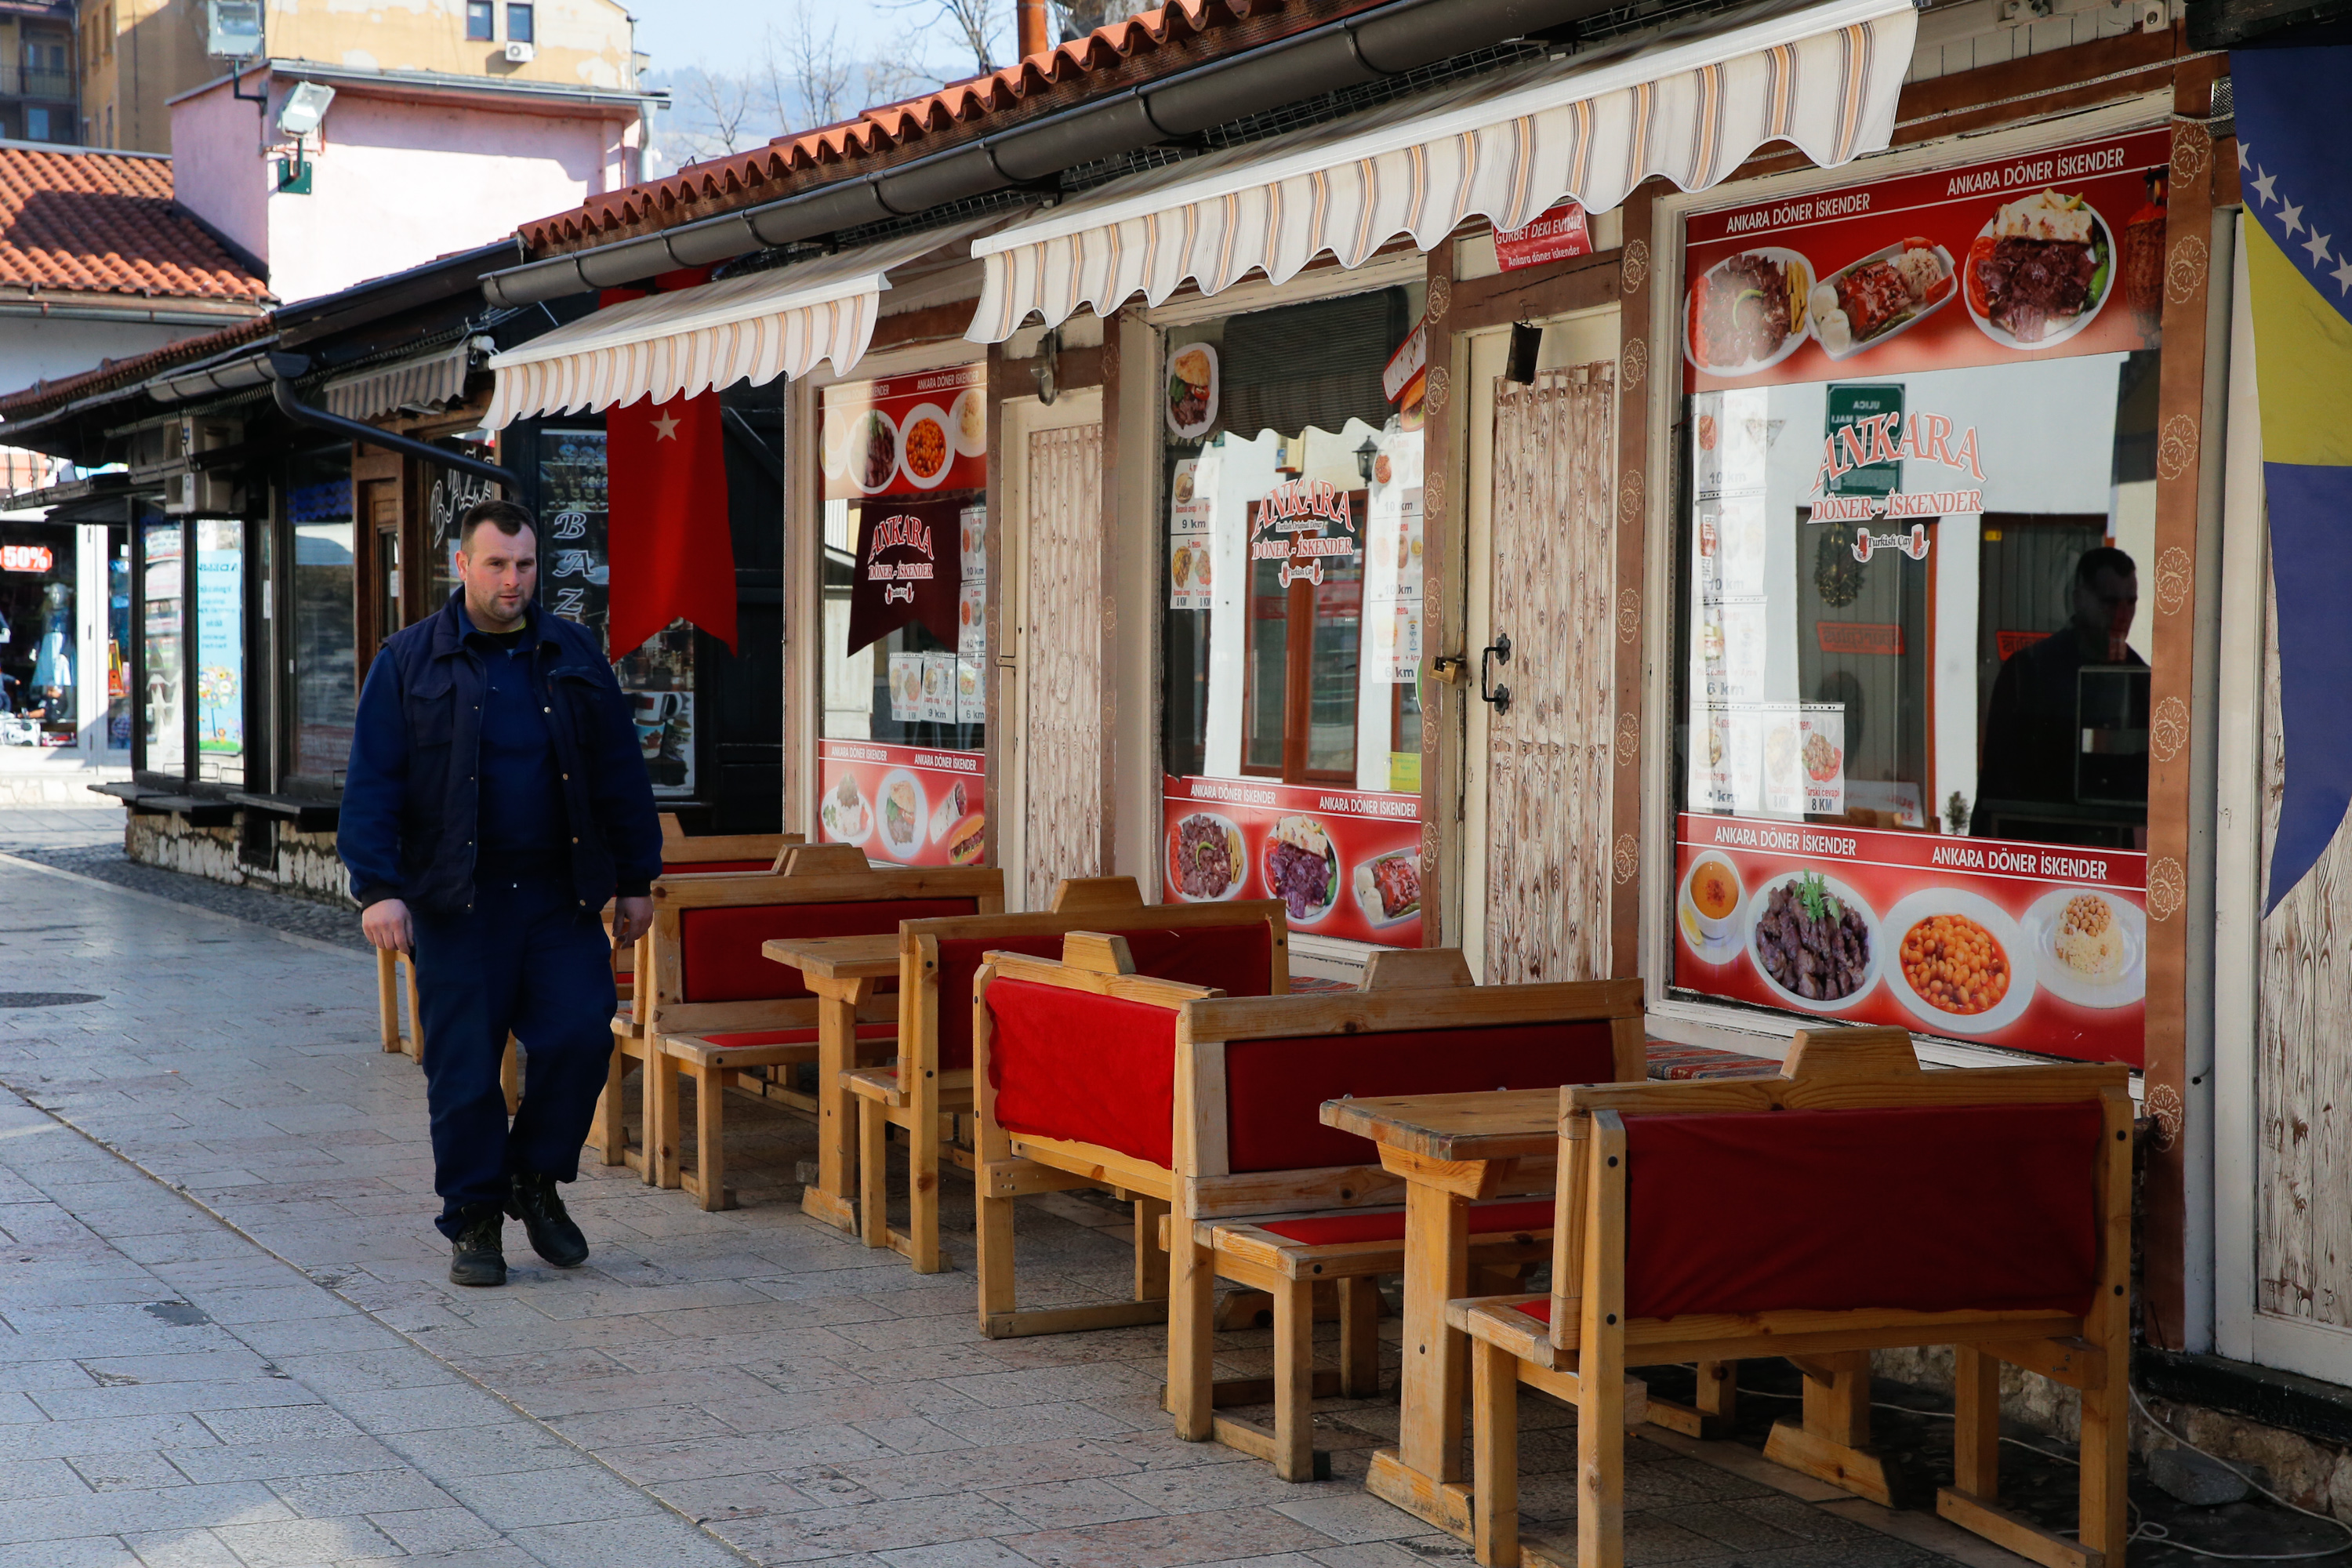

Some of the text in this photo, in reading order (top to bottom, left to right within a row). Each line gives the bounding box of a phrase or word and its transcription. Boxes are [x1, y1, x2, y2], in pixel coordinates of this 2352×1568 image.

[1947, 147, 2125, 196] ANKARA DÖNER İSKENDER
[1726, 193, 1871, 234] ANKARA DÖNER İSKENDER
[1508, 245, 1580, 267] Ankara döner iskender
[916, 379, 936, 390] ANKARA
[937, 373, 954, 387] DÖNER
[1808, 411, 1987, 499] ANKARA
[1709, 471, 1722, 484] 10
[1250, 478, 1356, 542] ANKARA
[1811, 492, 1875, 521] DÖNER
[1888, 488, 1983, 516] İSKENDER
[1181, 519, 1206, 528] 9 km
[868, 514, 935, 564] ANKARA
[1253, 538, 1291, 558] DÖNER
[1298, 535, 1352, 556] İSKENDER
[1867, 534, 1897, 547] Turkish
[4, 546, 48, 569] 50%
[869, 561, 894, 579] DÖNER
[967, 567, 973, 575] 10
[1398, 584, 1412, 594] km
[1396, 666, 1414, 677] km
[1707, 682, 1744, 695] 6 km
[935, 709, 946, 719] km
[966, 710, 985, 719] 6 km
[831, 746, 849, 757] ANKARA
[849, 746, 866, 759] DÖNER
[914, 753, 934, 766] ANKARA
[935, 753, 952, 768] DÖNER
[1190, 784, 1276, 804] ANKARA DÖNER İSKENDER
[1805, 786, 1820, 797] Turski
[1319, 796, 1416, 817] ANKARA DÖNER İSKENDER
[1812, 798, 1832, 811] 8 KM
[1715, 826, 1856, 856] ANKARA DÖNER İSKENDER
[1932, 846, 2107, 880] ANKARA DÖNER İSKENDER
